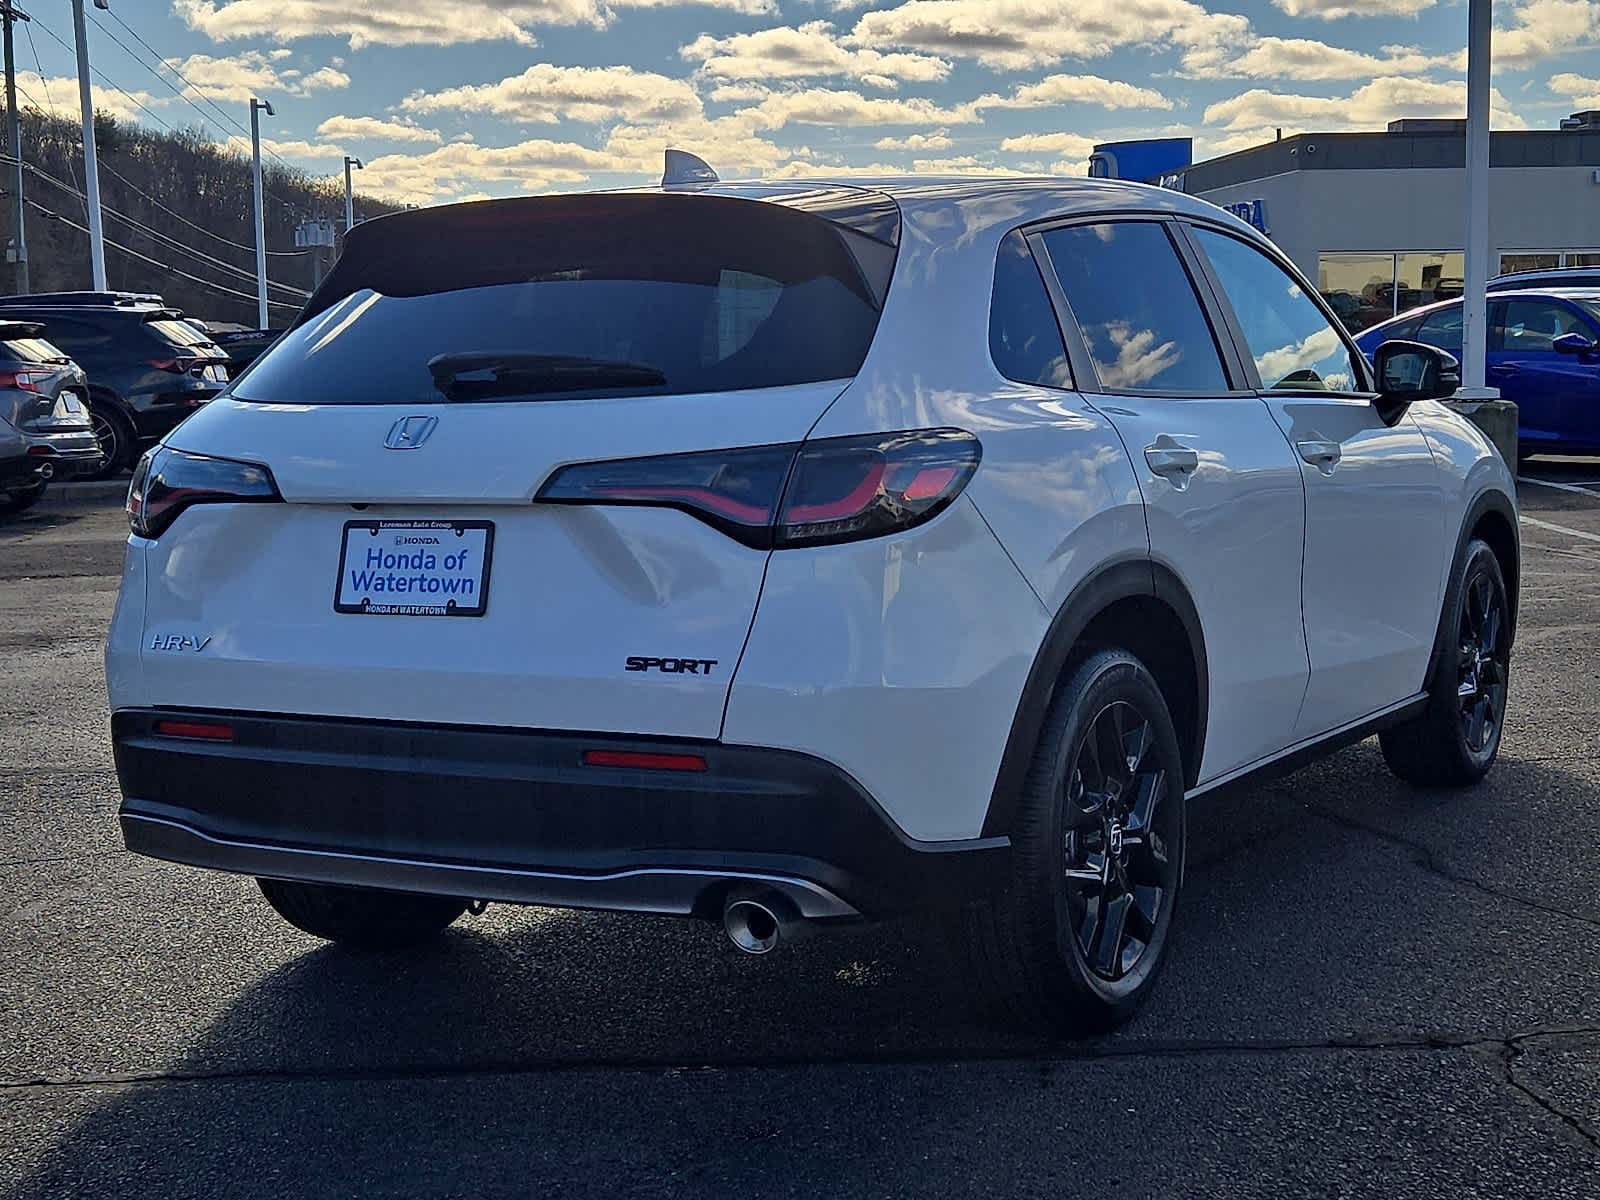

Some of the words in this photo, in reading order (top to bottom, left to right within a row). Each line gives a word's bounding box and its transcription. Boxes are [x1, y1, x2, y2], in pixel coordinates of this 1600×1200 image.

[404, 537, 440, 545] HONDA
[366, 548, 436, 570] Honda
[444, 549, 469, 571] of
[351, 570, 474, 594] Watertown
[365, 605, 391, 613] HONDA
[400, 606, 447, 615] WATERTOWN
[151, 634, 212, 652] HR-V
[625, 656, 718, 675] SPORT
